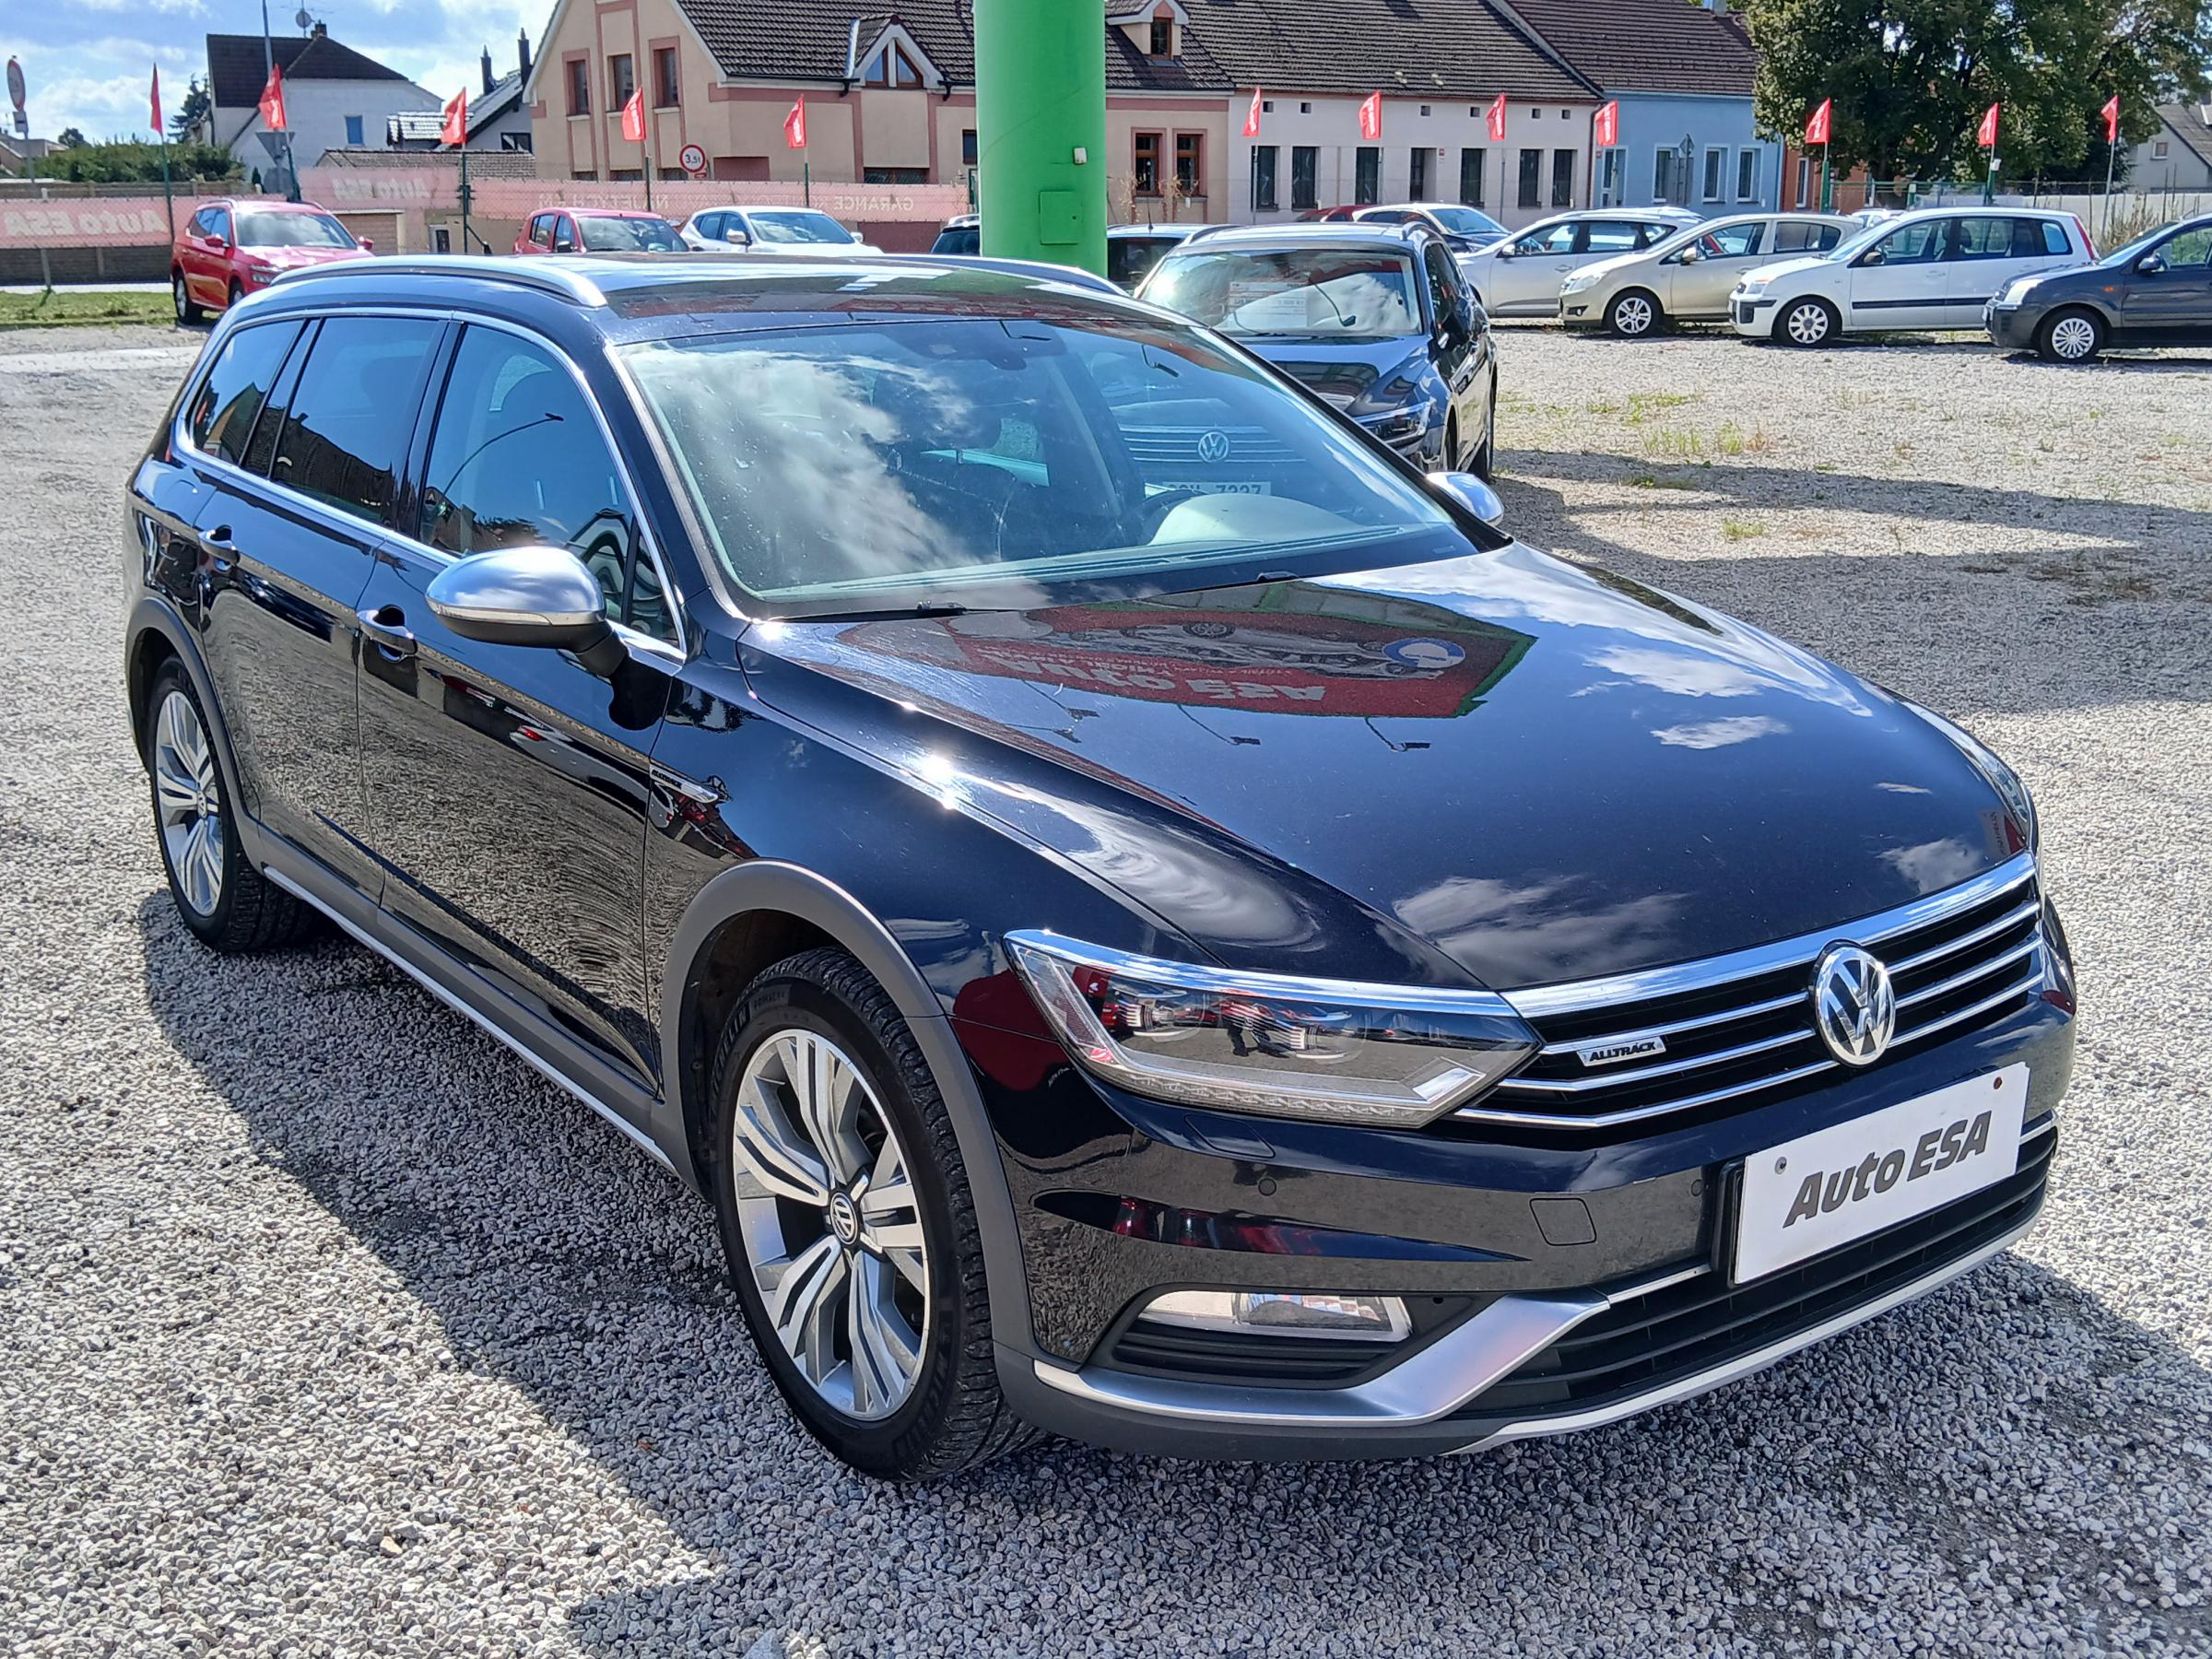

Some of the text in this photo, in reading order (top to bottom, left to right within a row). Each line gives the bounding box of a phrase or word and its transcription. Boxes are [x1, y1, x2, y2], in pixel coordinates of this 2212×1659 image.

[1589, 1041, 1656, 1062] ALLTRACK
[1783, 1111, 1993, 1229] Auto ESA
